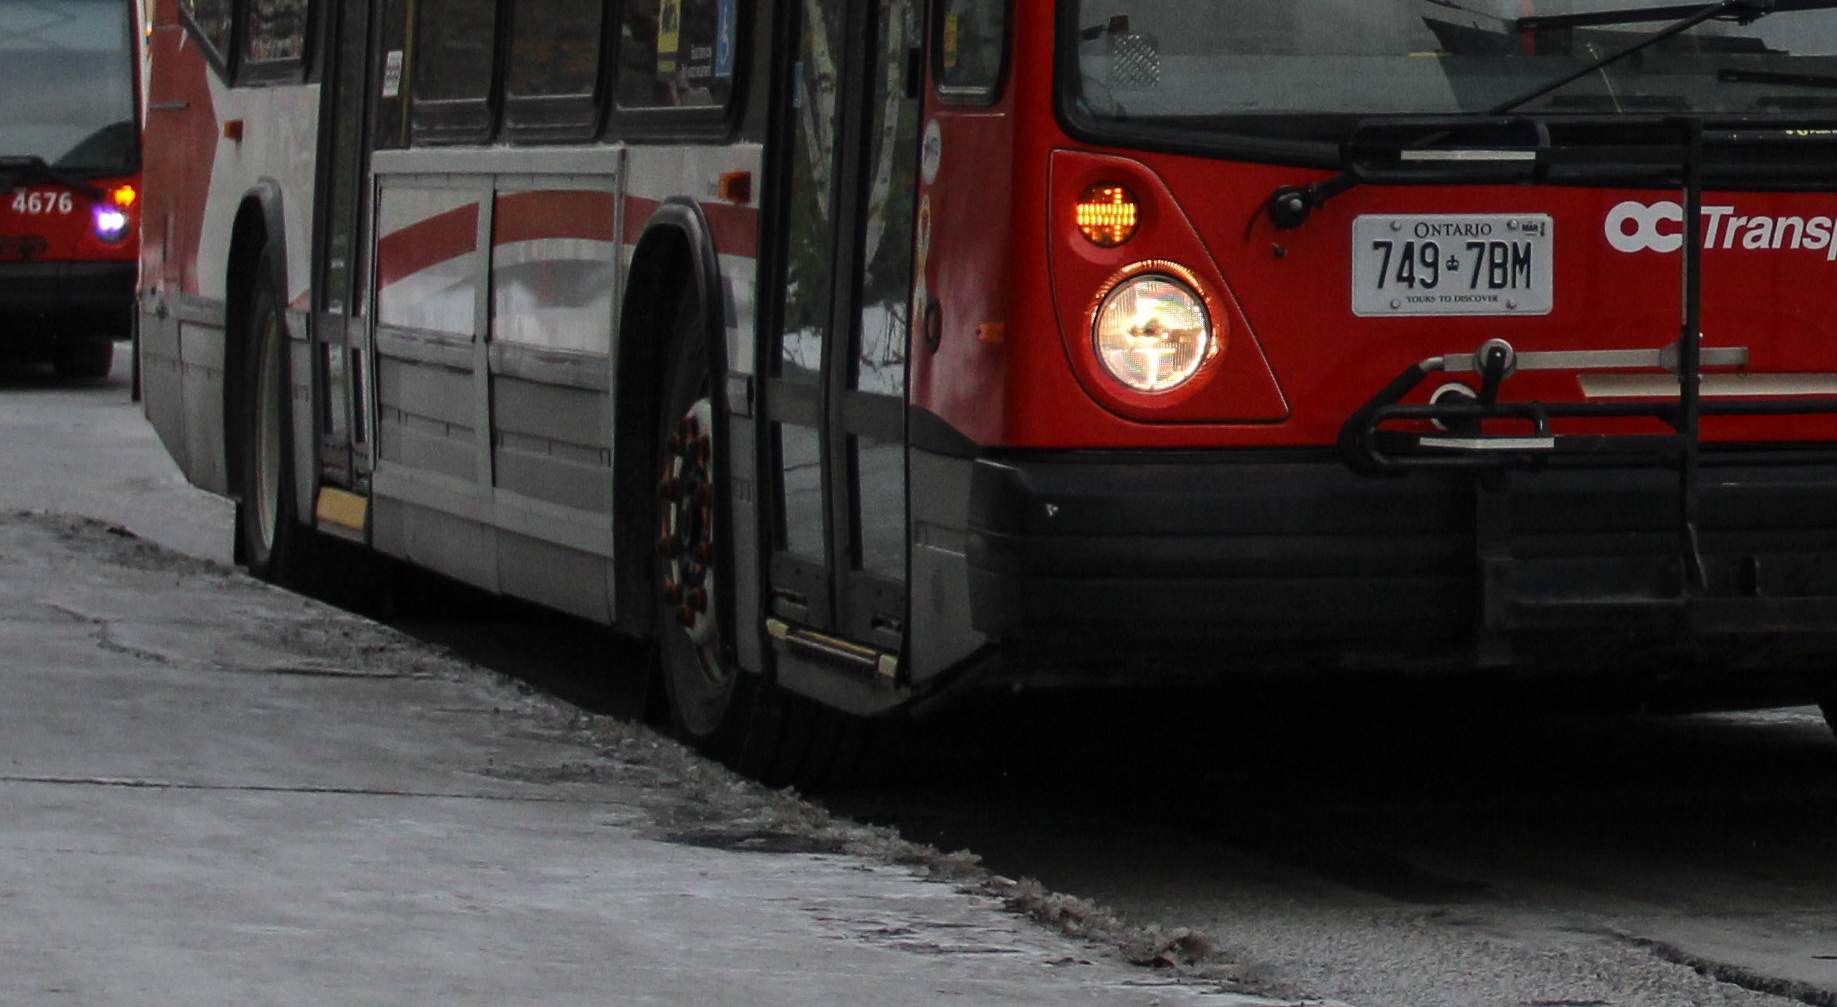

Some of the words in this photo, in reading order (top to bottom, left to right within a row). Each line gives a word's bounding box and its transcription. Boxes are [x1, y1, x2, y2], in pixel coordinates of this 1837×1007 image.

[12, 194, 73, 214] 4676
[1414, 222, 1492, 239] ONTARIO
[1604, 200, 1684, 253] OC
[1373, 241, 1440, 289] 749
[1465, 241, 1532, 289] 7BM
[1407, 295, 1436, 304] YOURS
[1439, 295, 1451, 304] TO
[1454, 294, 1499, 304] DISCOVER
